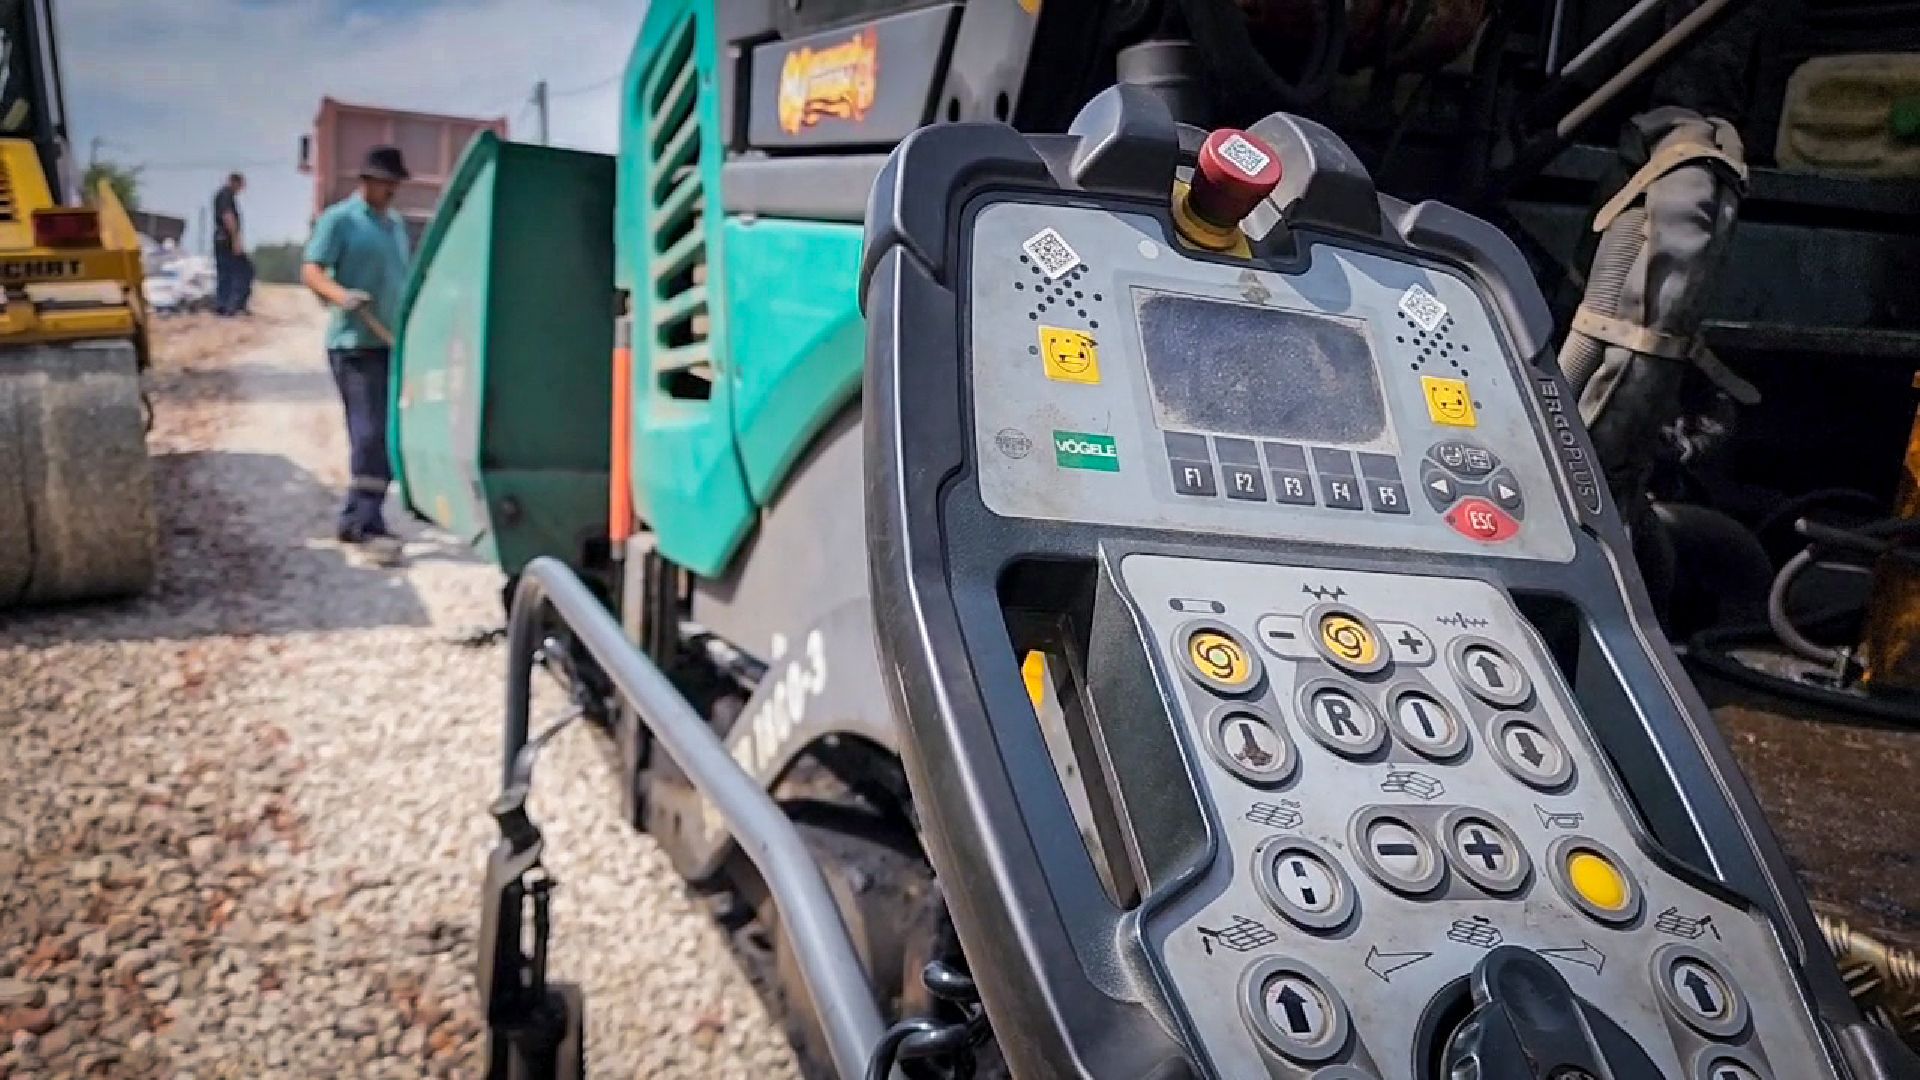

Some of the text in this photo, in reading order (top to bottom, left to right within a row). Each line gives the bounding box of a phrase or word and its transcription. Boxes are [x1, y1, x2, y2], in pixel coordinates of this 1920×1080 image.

[1538, 377, 1596, 497] ERGOPLUS
[1055, 438, 1117, 458] VÖGELE
[1184, 467, 1202, 488] F1
[1235, 472, 1255, 493] F2
[1283, 476, 1303, 497] F3
[1331, 481, 1351, 502] F4
[1377, 486, 1397, 506] F5
[1469, 510, 1496, 531] ESC
[1320, 699, 1363, 737] R
